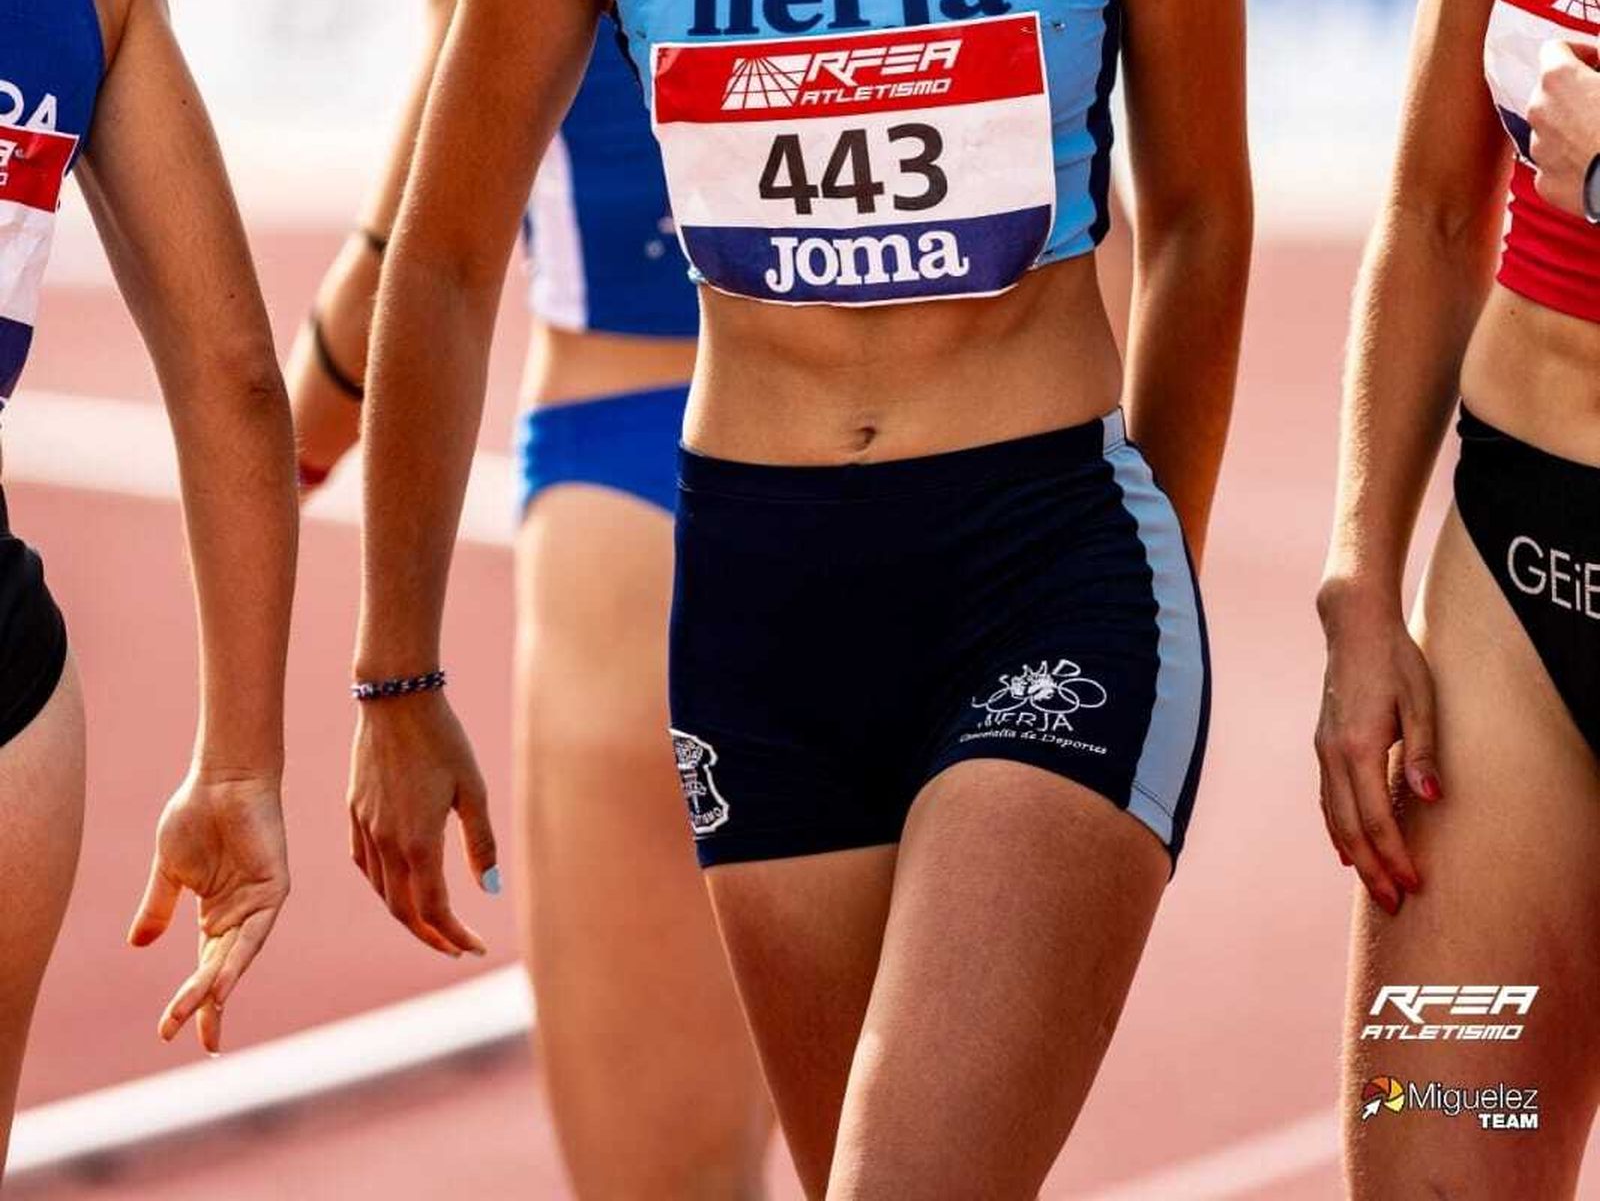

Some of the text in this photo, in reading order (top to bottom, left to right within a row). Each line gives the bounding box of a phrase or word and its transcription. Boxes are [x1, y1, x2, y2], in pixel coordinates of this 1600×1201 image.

[801, 38, 962, 86] RFEA
[800, 76, 952, 105] ATLETISMO
[758, 122, 948, 215] 443
[1038, 731, 1107, 755] Deportes
